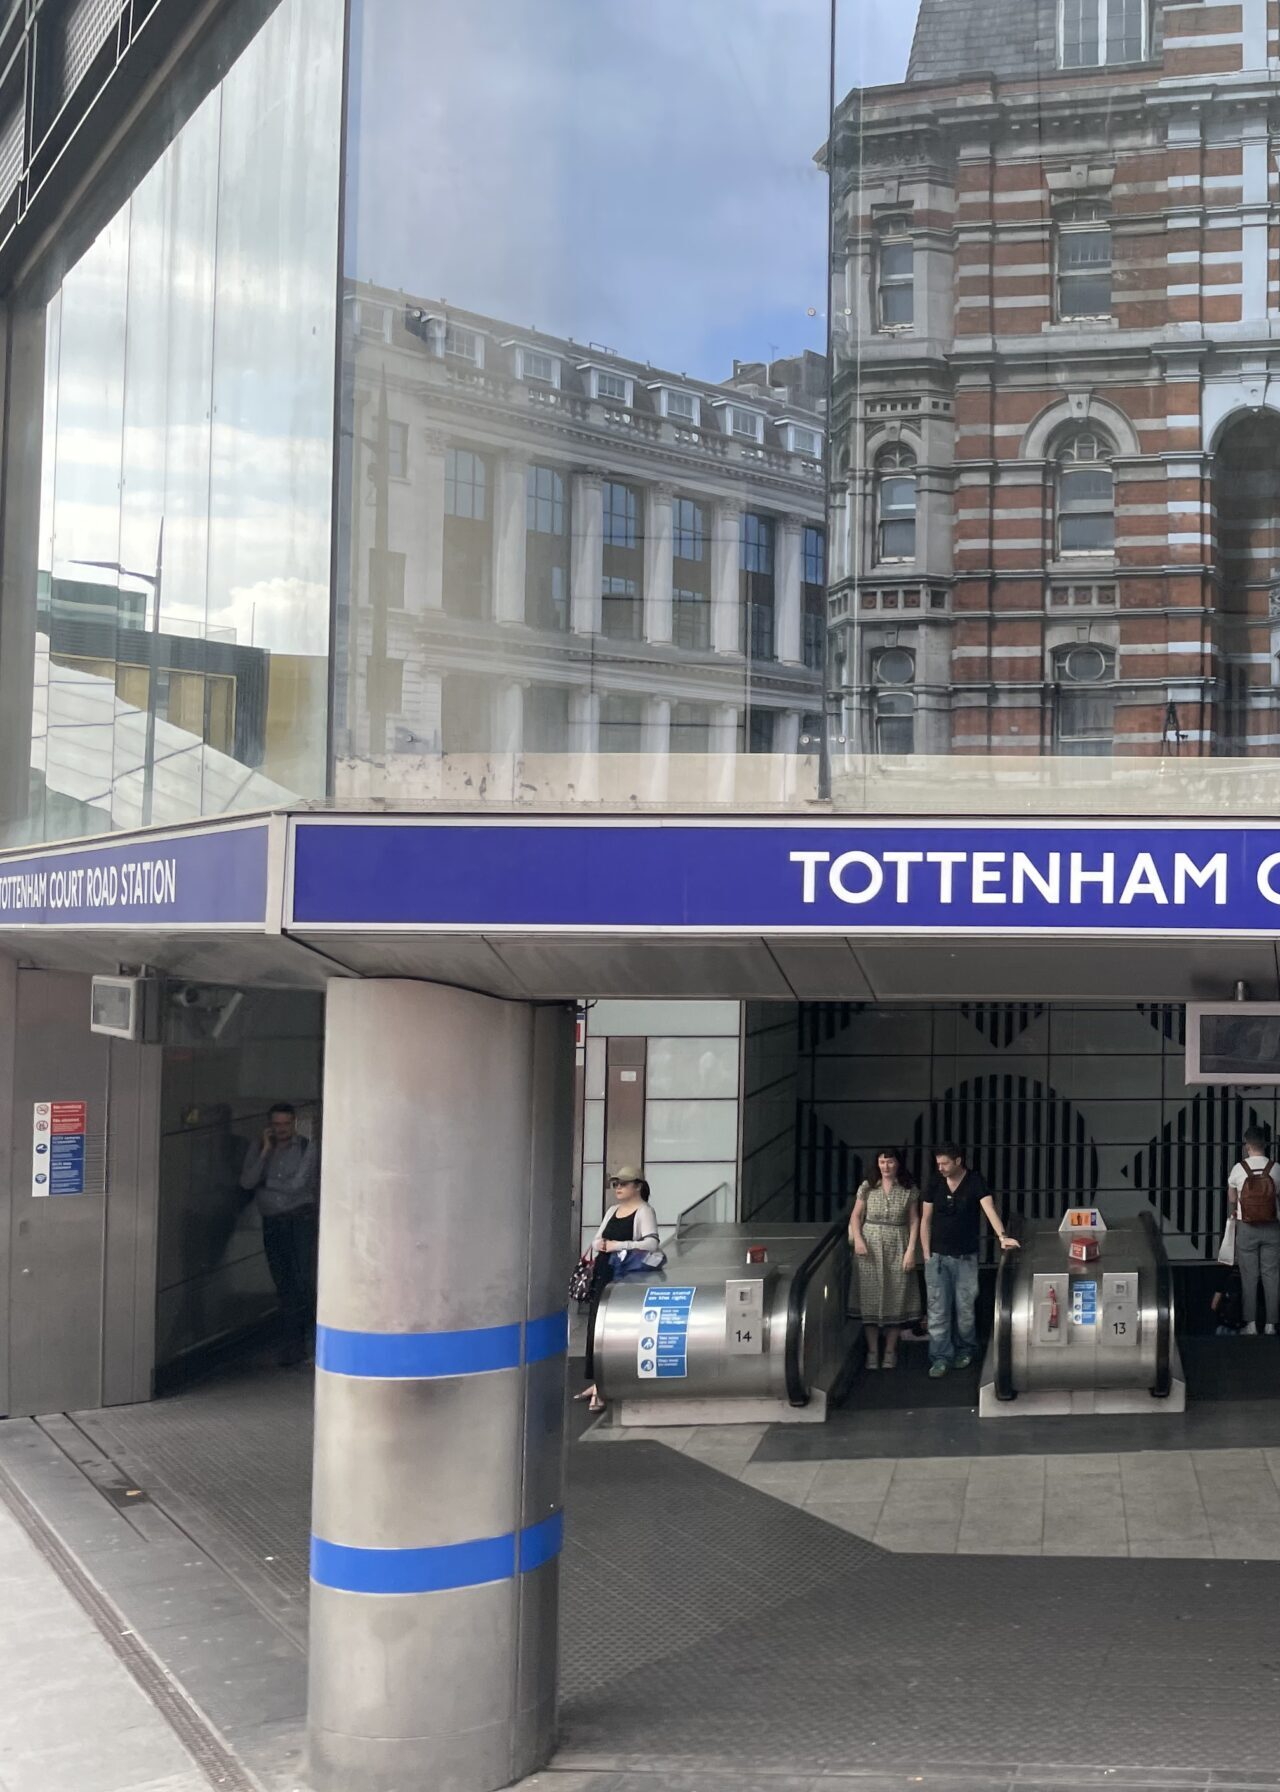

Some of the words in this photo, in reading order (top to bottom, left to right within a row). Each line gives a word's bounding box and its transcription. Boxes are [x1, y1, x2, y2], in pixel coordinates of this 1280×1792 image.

[50, 869, 84, 909] COURT
[87, 866, 118, 907] ROAD
[121, 858, 176, 906] STATION
[789, 850, 1228, 905] TOTTENHAM
[736, 1330, 752, 1342] 14
[1113, 1322, 1126, 1335] 13
